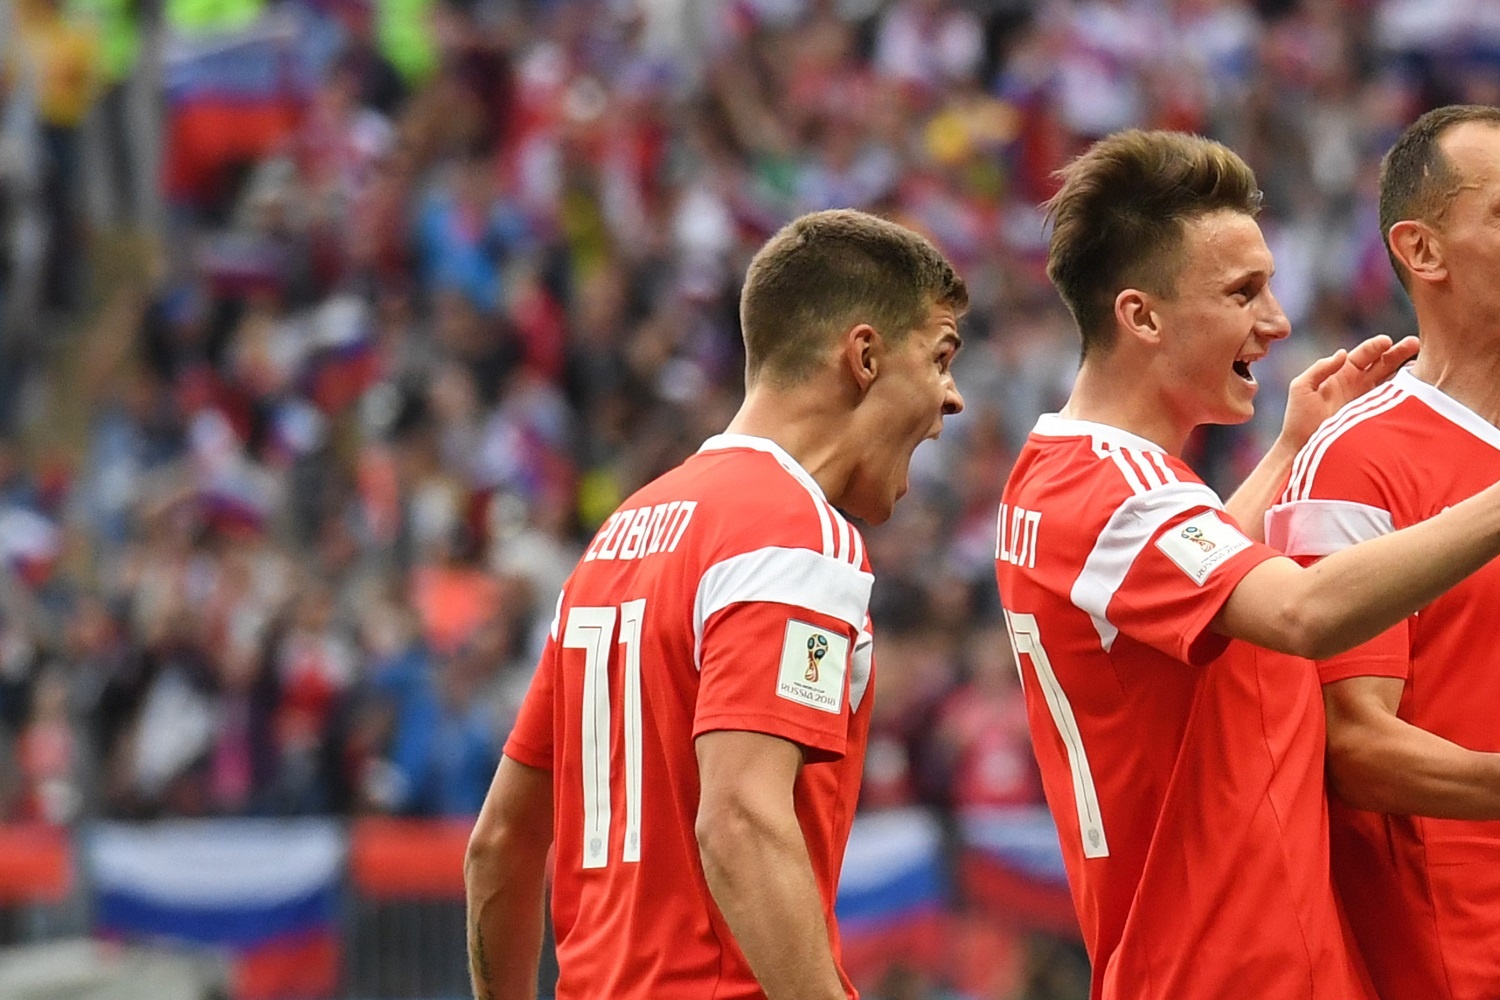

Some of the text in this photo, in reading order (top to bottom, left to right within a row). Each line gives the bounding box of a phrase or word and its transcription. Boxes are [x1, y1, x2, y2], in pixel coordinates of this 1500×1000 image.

[583, 500, 698, 563] ZOBNIN
[781, 683, 836, 706] RUSSIA 2018
[562, 597, 647, 869] 11
